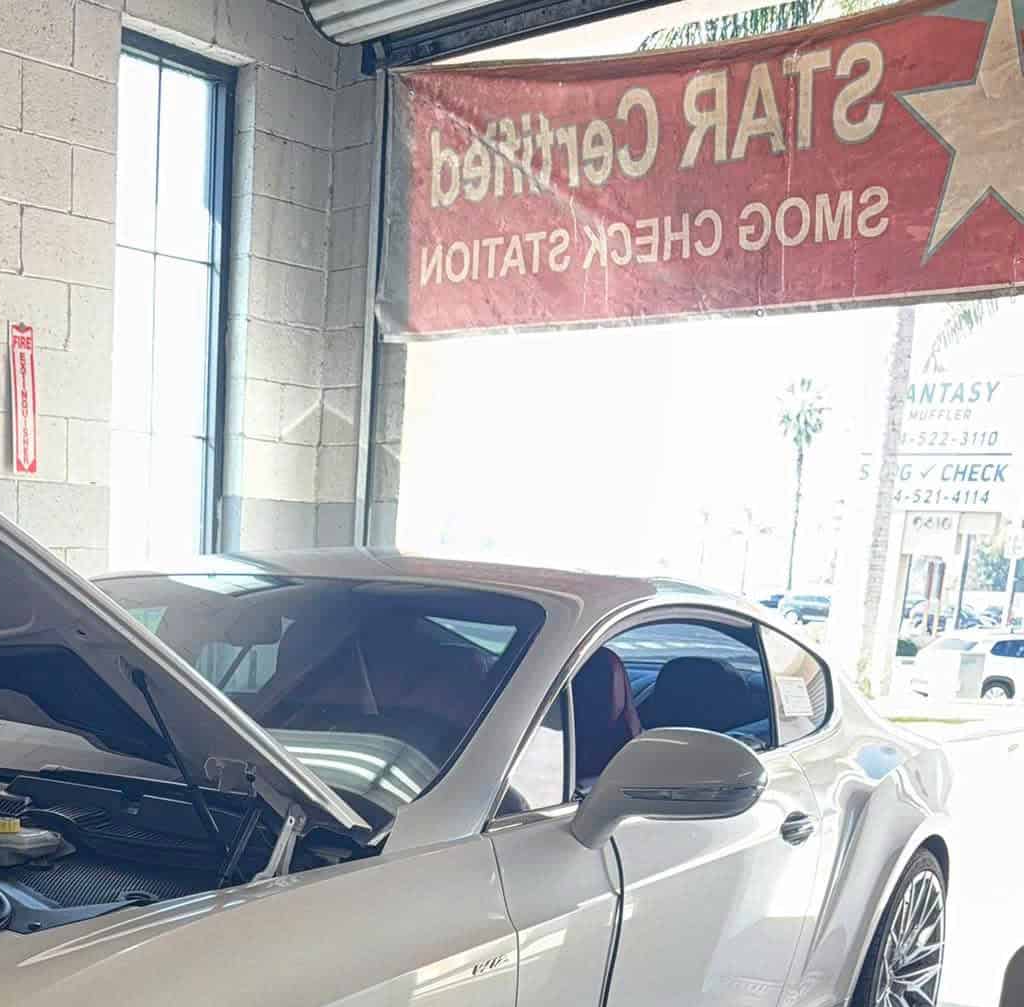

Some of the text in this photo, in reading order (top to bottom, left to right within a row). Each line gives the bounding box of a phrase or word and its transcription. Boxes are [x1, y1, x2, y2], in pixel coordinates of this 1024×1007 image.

[12, 336, 33, 350] FIRE
[905, 381, 1000, 403] ANTASY
[908, 408, 973, 422] MUFFLER
[941, 463, 1009, 482] CHECK
[893, 489, 990, 505] 4-521-4114
